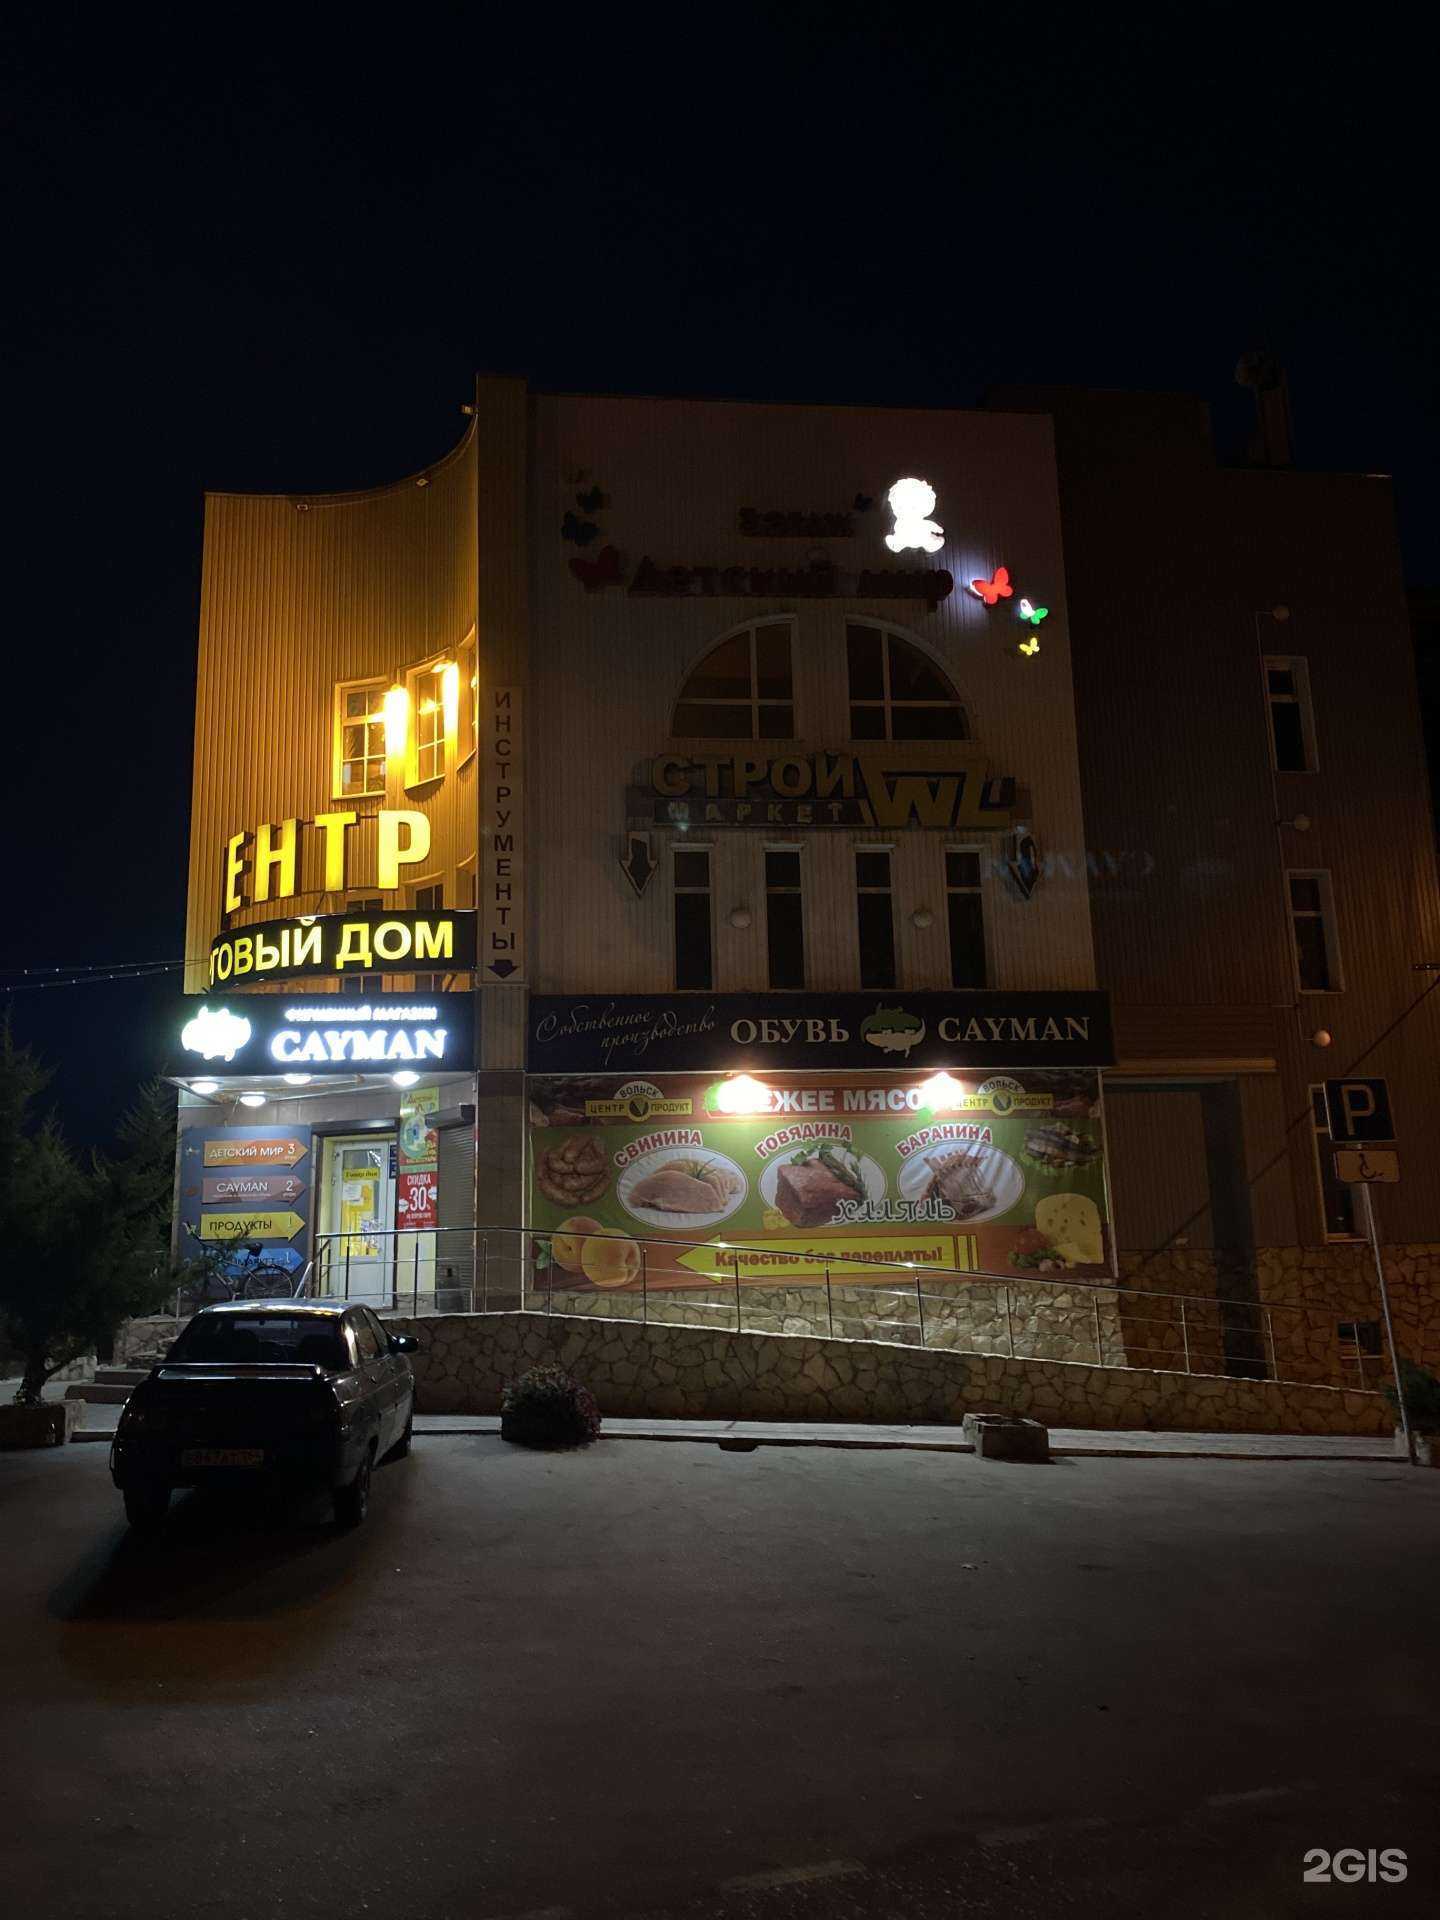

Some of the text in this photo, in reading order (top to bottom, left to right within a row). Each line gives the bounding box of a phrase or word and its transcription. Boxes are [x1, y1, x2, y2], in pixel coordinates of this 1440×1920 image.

[652, 751, 855, 798] СТРОЙ
[492, 691, 515, 950] ИНСТРУМЕНТЫ
[667, 802, 843, 823] МАРКЕТ
[226, 809, 430, 914] ЕНТР
[209, 915, 453, 985] ГОВЫЙ ДОМ
[536, 1002, 651, 1042] Собственное
[600, 1005, 715, 1066] производство
[730, 1018, 850, 1043] ОБУВЬ
[937, 1016, 1090, 1042] CAYMAN
[270, 1029, 447, 1061] CAYMAN
[619, 1082, 660, 1099] ВОЛЬСК
[755, 1089, 835, 1113] ЕЖЕЕ
[590, 1101, 690, 1114] ЦЕНТР ПРОДУКТ
[209, 1143, 295, 1159] ДЕТСКИЙ МИР 3
[615, 1129, 703, 1168] СВИНИНА
[755, 1122, 853, 1159] ГОВЯДИНА
[896, 1123, 993, 1159] БАРАНИНА
[217, 1180, 293, 1193] CAYMAN 2
[209, 1220, 272, 1232] ПРОДУКТЫ
[715, 1250, 800, 1267] Качество
